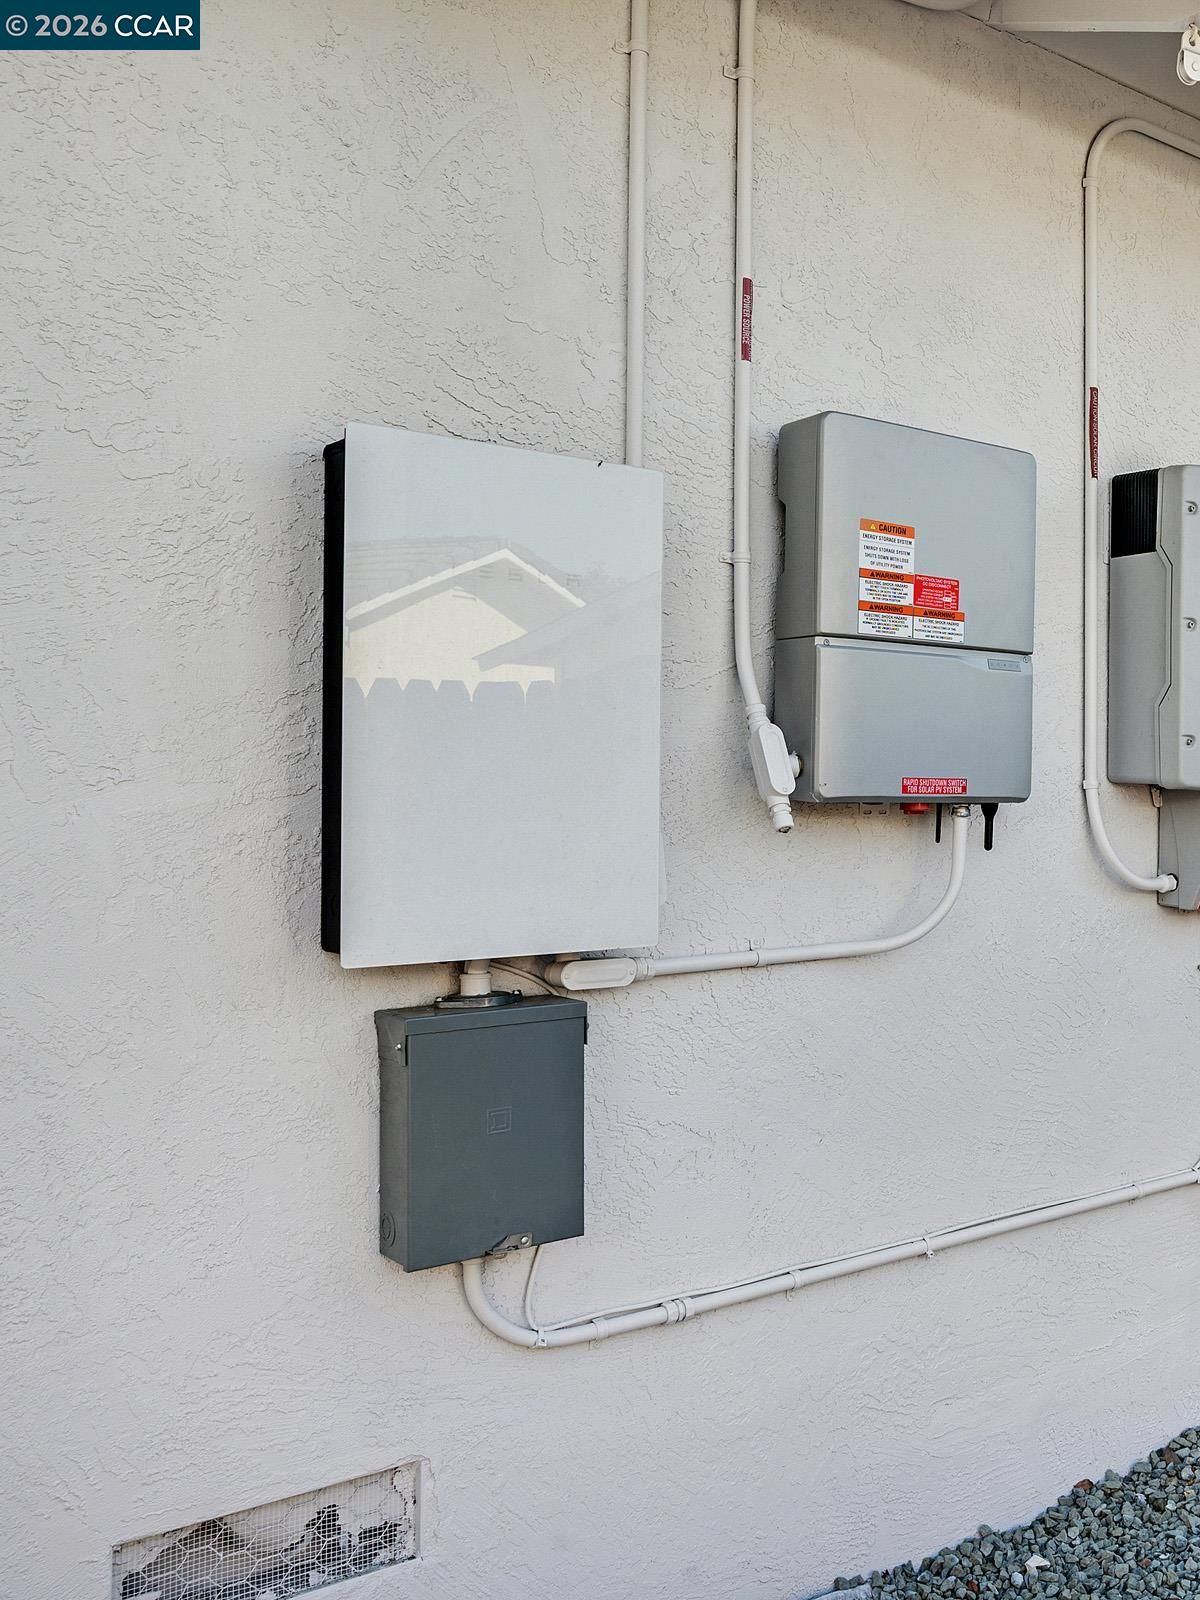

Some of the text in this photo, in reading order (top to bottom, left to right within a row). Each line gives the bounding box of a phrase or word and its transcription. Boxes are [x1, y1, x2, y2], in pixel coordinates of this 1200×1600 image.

[742, 318, 751, 344] SOURCE
[878, 524, 906, 535] CAUTION
[878, 535, 896, 543] STORAGE
[875, 571, 904, 580] WARNING
[874, 604, 903, 613] WARNING
[928, 610, 955, 618] WARNING
